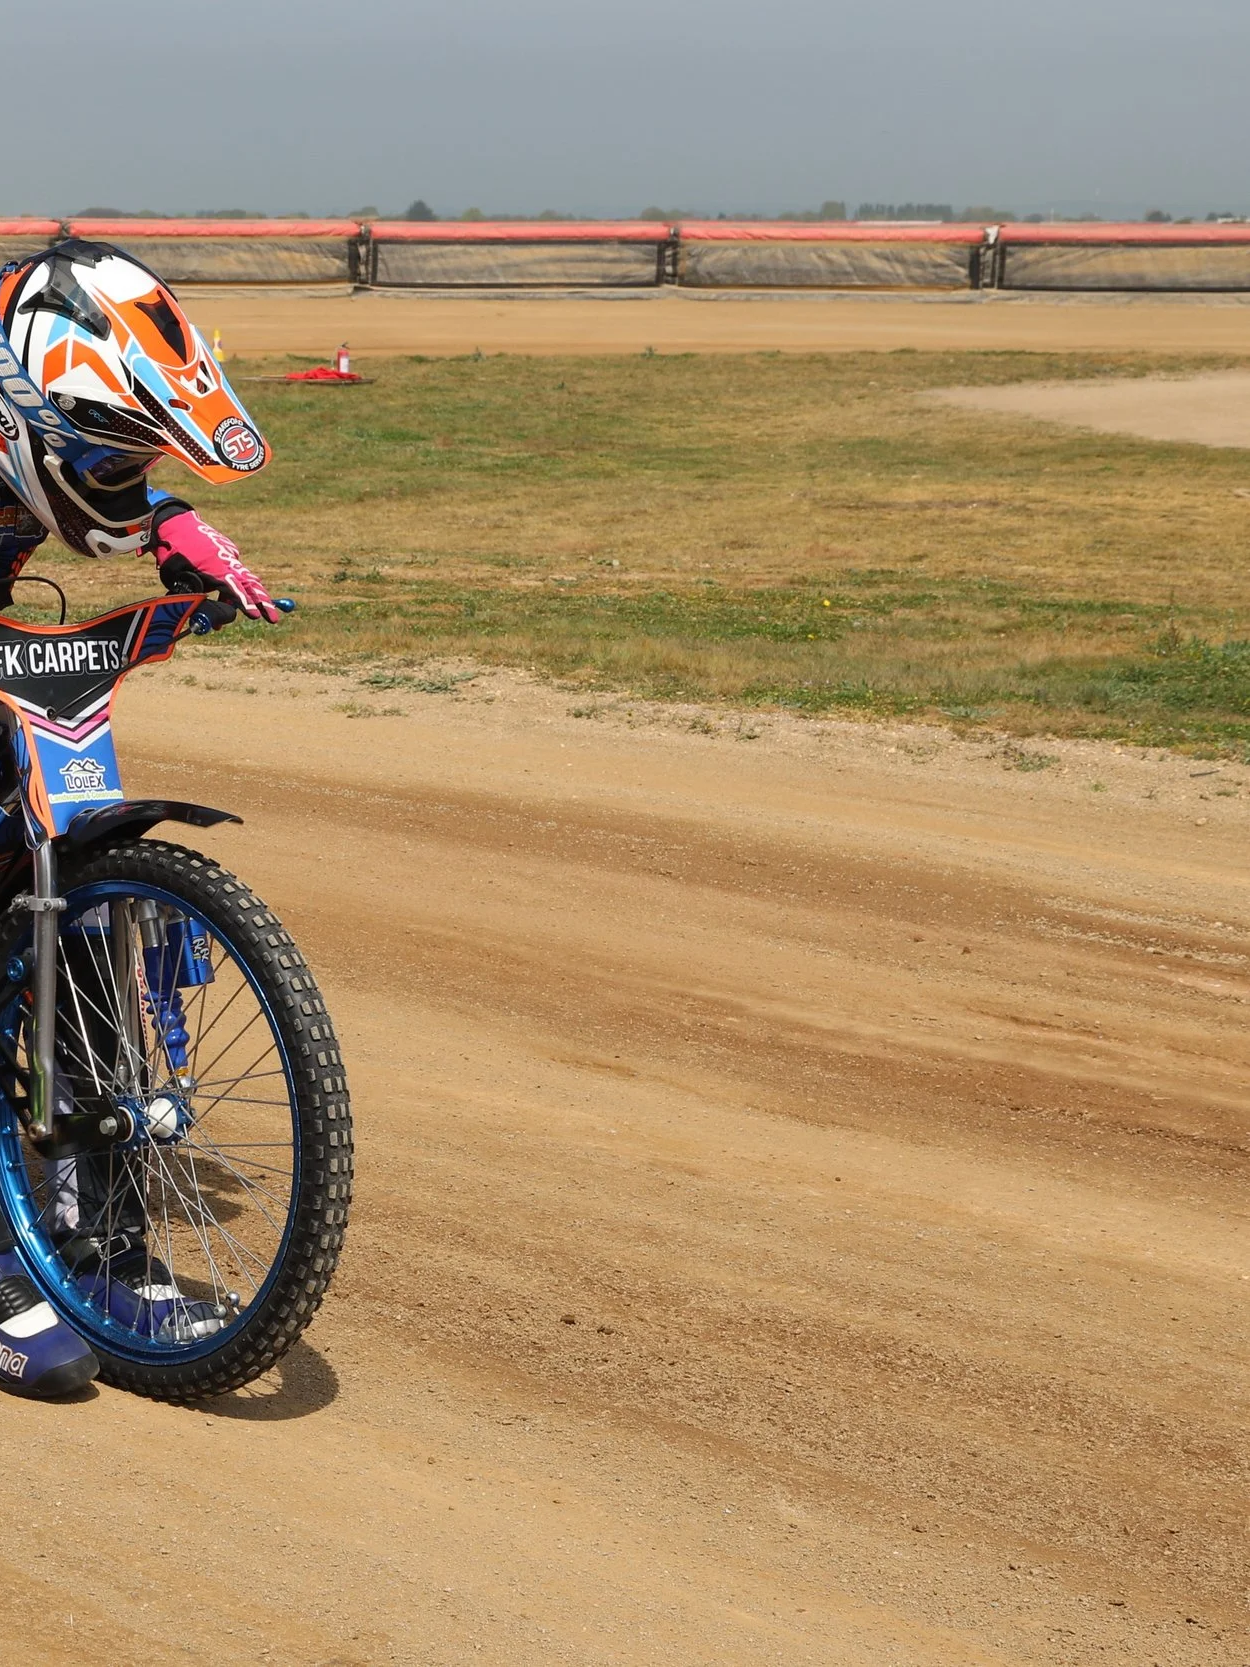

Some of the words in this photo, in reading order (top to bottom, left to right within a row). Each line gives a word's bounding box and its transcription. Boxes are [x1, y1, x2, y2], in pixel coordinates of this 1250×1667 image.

[214, 417, 244, 444] STAKEFORD
[224, 430, 254, 459] STS
[29, 639, 120, 674] CARPETS
